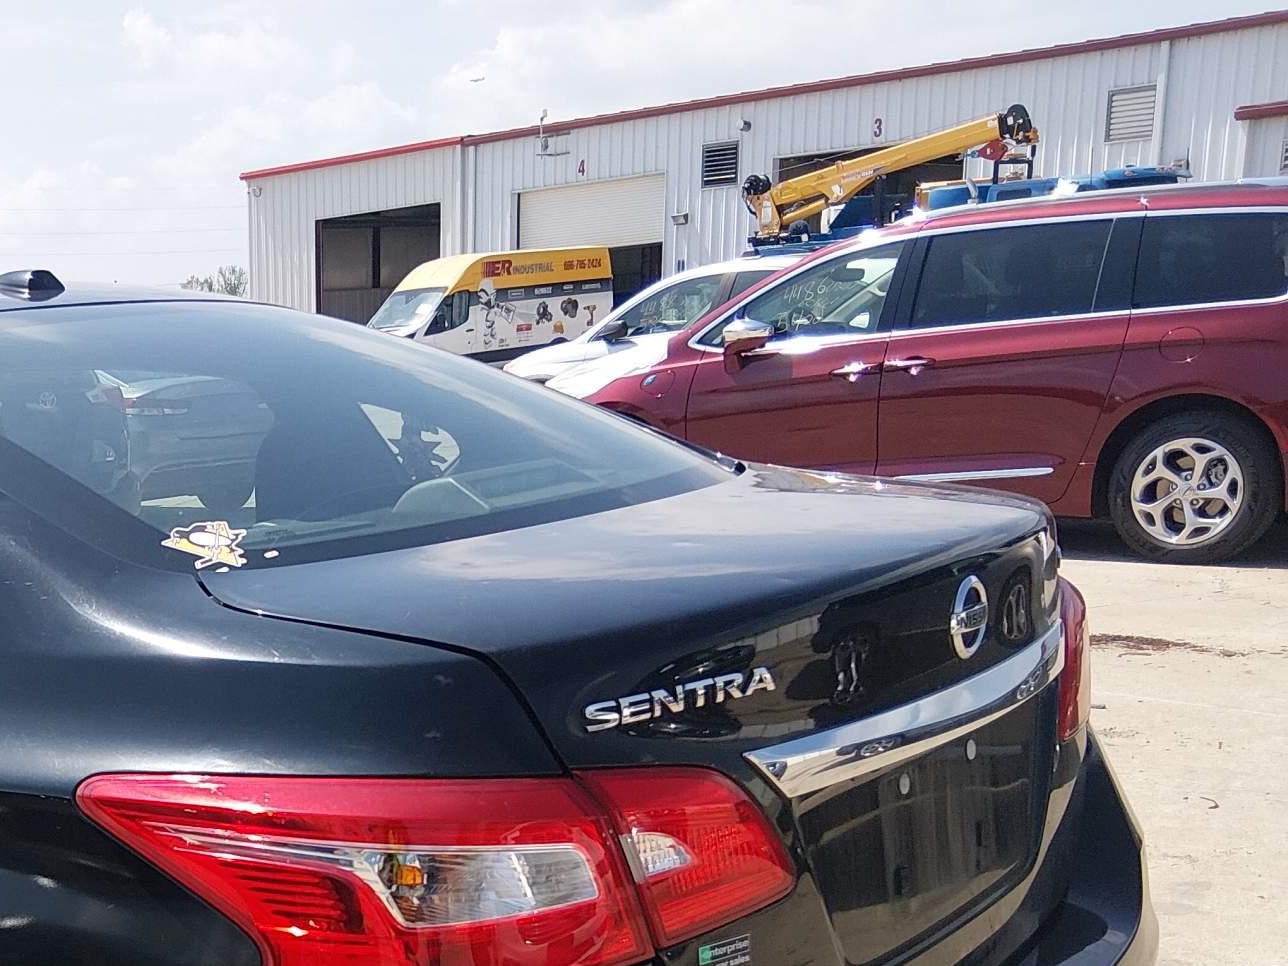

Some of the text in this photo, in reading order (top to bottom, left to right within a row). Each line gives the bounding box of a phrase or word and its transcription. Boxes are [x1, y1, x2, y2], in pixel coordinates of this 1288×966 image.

[873, 118, 883, 138] 3
[578, 159, 585, 176] 4
[513, 262, 554, 275] INDUSTRIAL
[584, 666, 777, 733] SENTRA
[702, 939, 751, 959] enterprise
